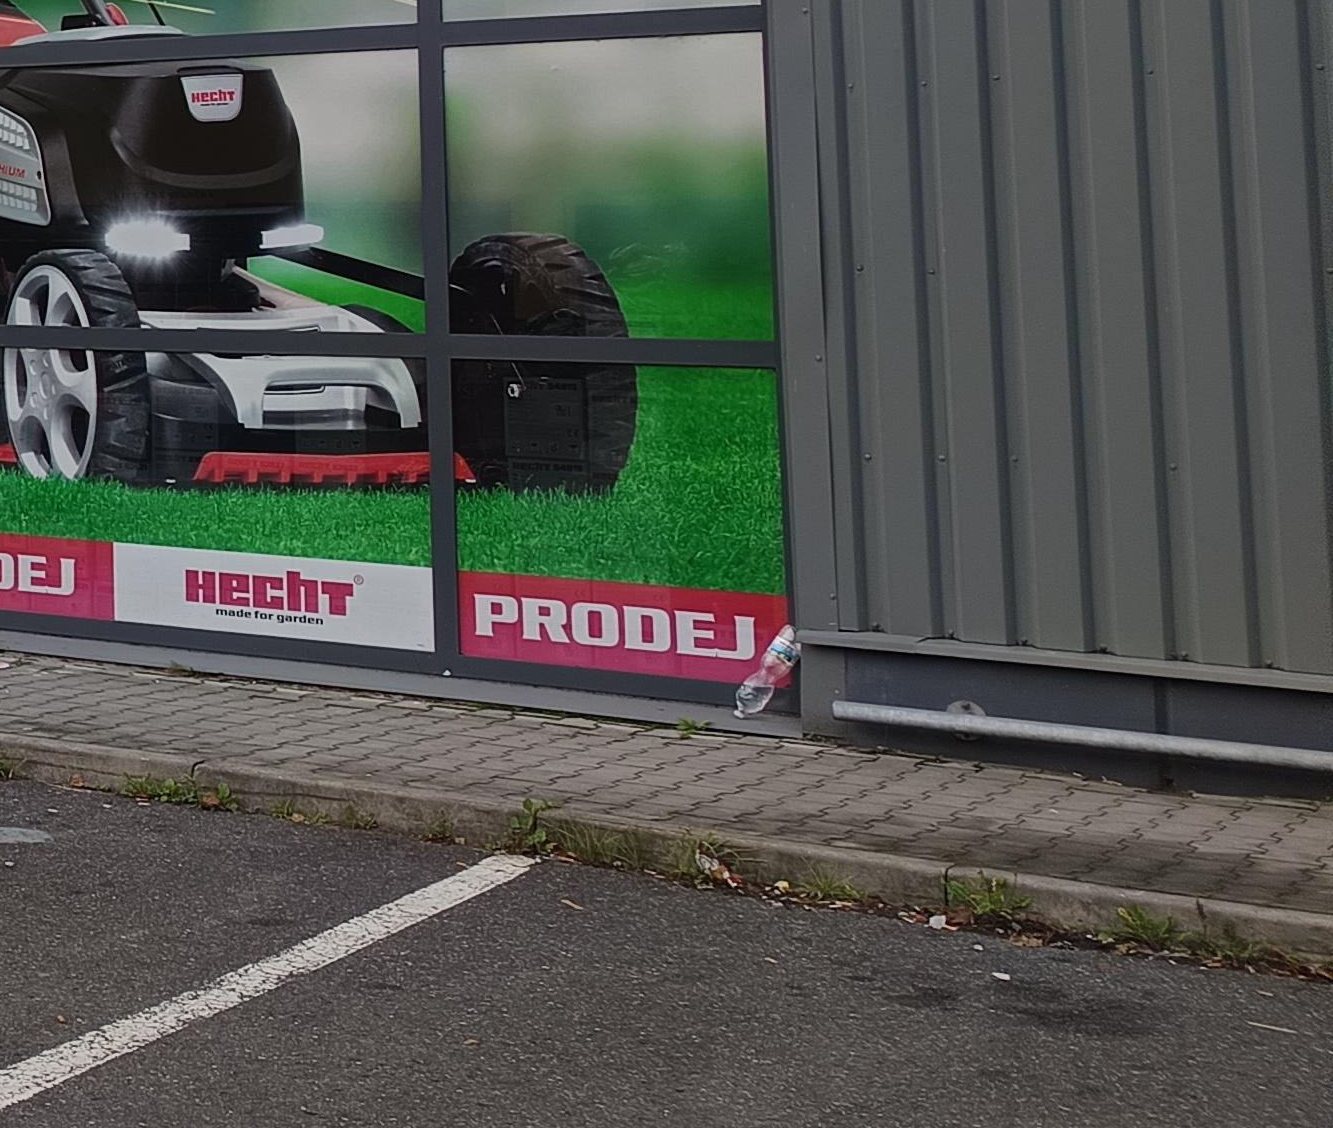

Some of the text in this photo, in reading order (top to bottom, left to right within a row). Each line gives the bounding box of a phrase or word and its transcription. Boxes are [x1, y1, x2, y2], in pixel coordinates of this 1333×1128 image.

[215, 608, 324, 626] made for garden
[473, 593, 756, 661] PRODEJ
